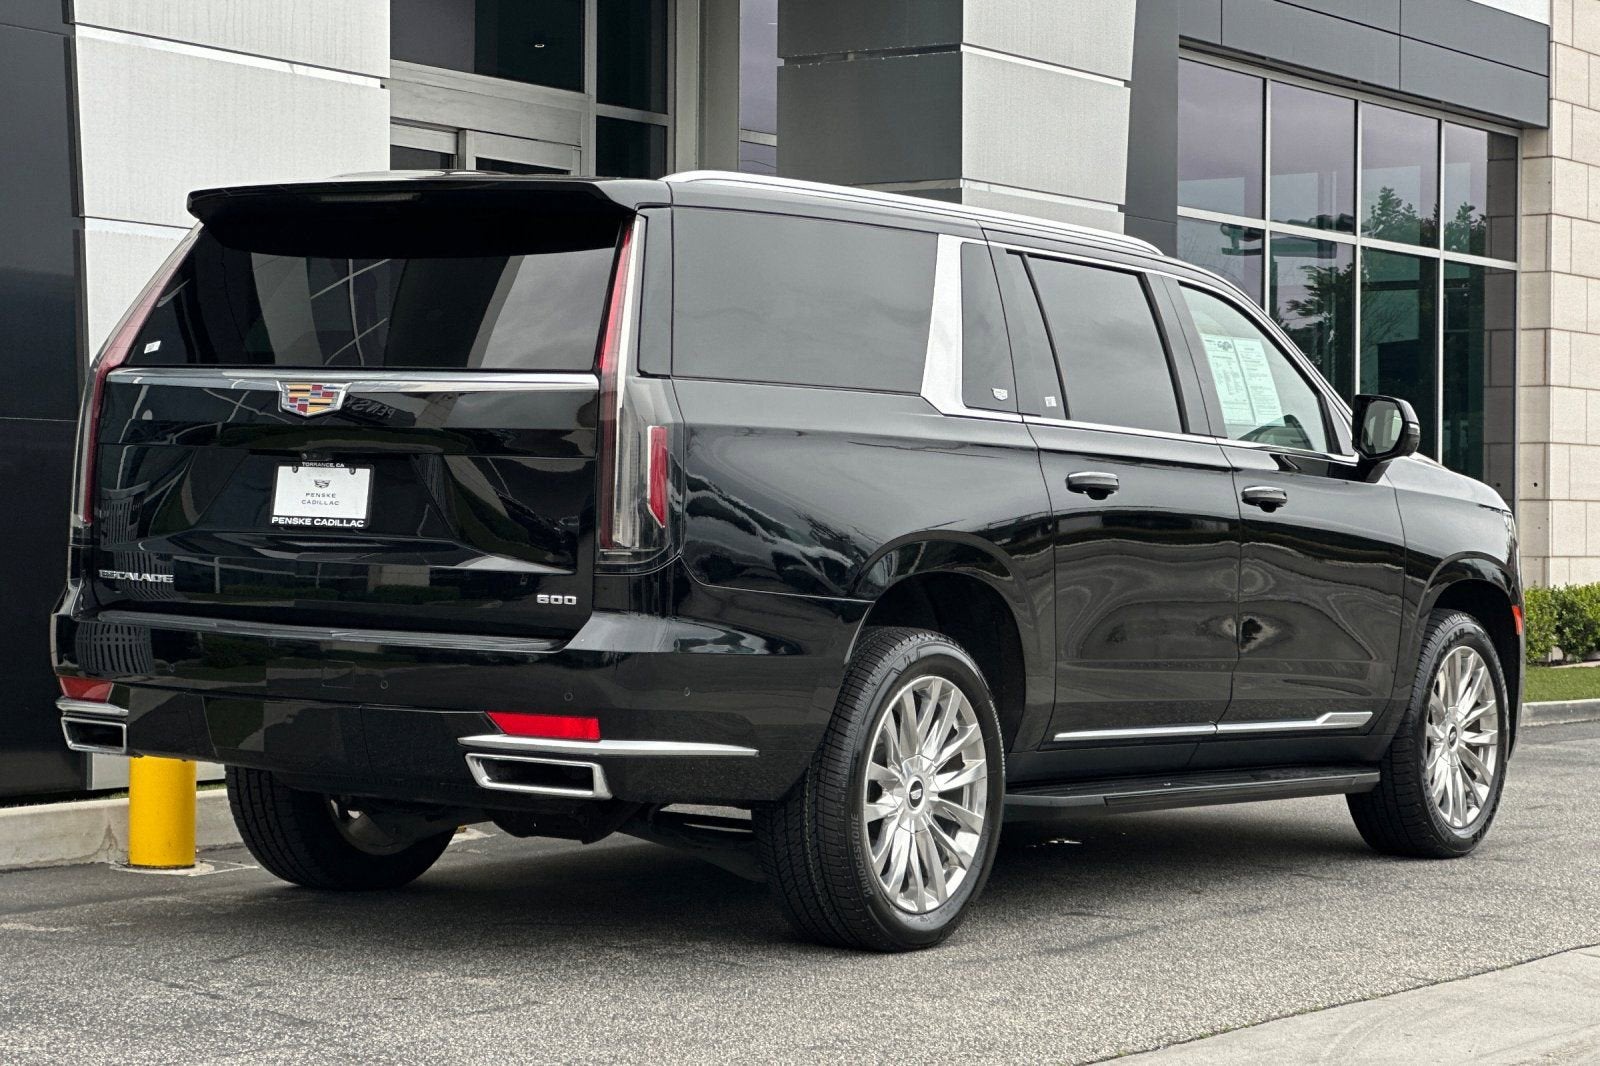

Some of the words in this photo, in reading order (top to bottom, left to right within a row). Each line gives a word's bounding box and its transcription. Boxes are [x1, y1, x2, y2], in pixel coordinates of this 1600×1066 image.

[271, 516, 311, 526] PENSKE
[313, 518, 364, 528] CADILLAC
[98, 569, 174, 583] ESCALADE
[536, 594, 577, 605] 600
[850, 813, 874, 898] BRIDGESTONE
